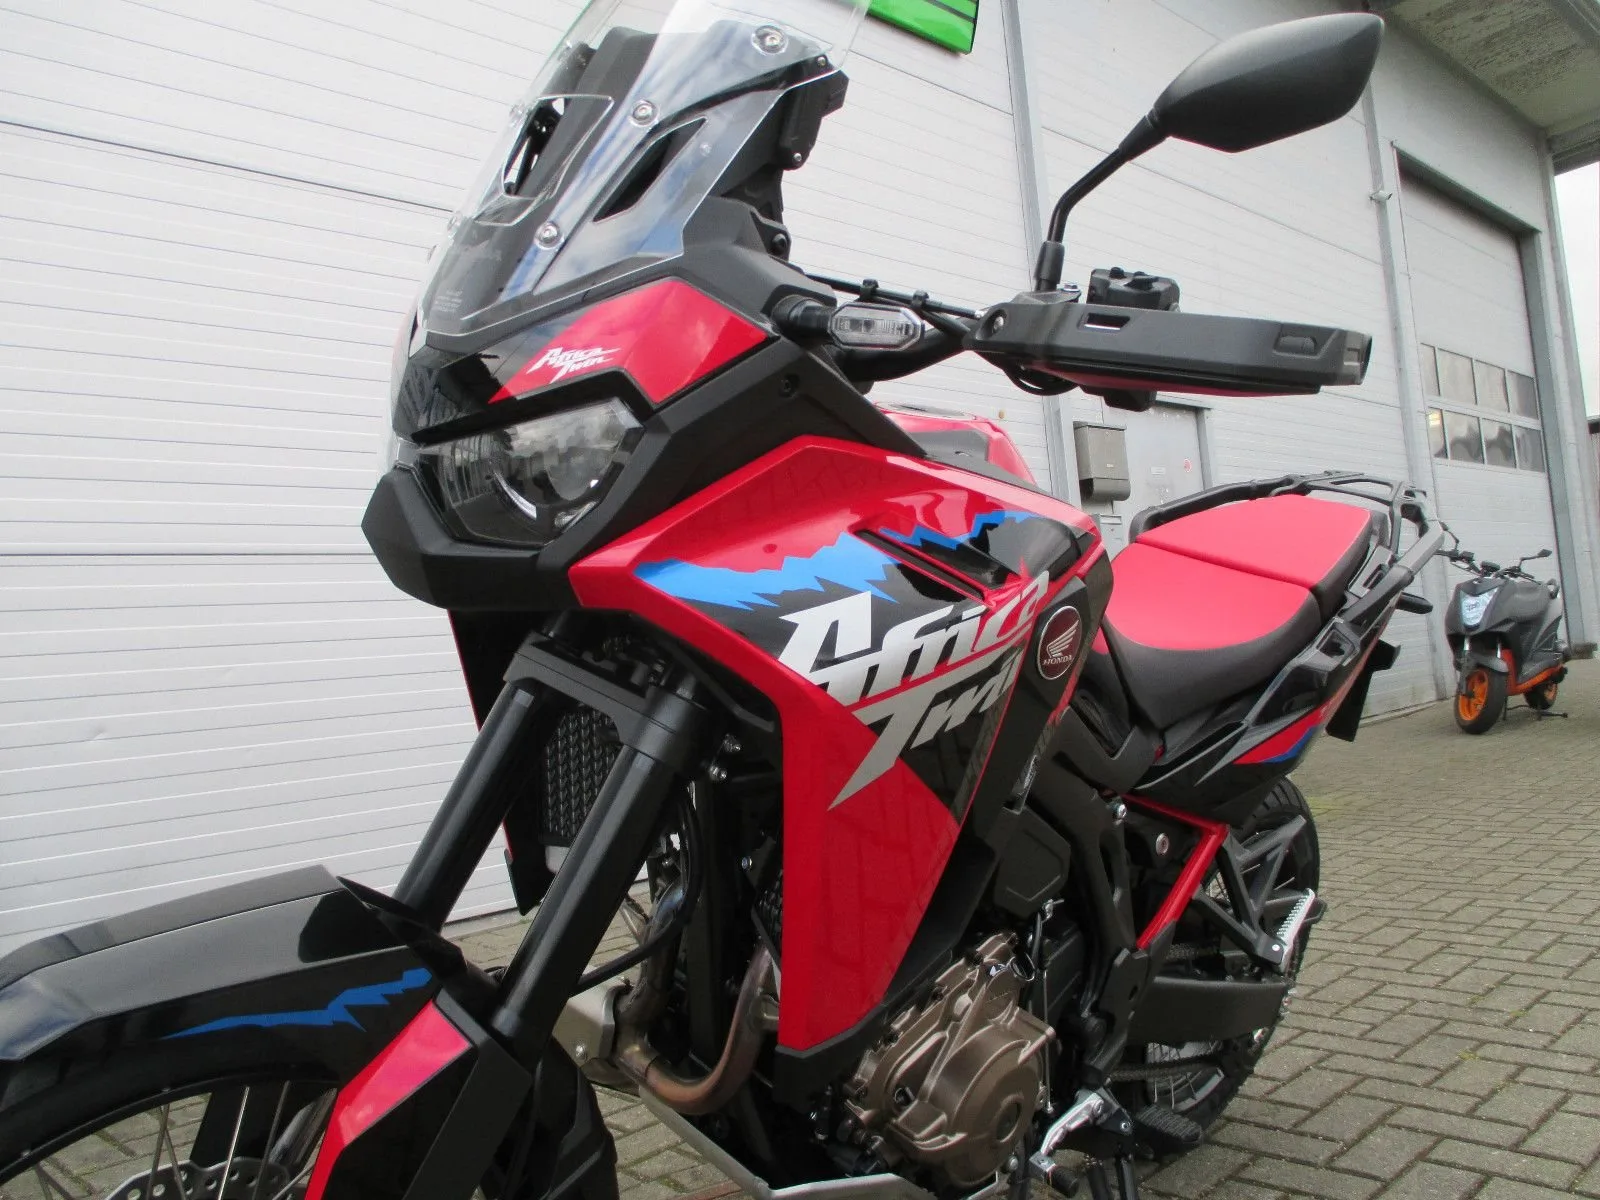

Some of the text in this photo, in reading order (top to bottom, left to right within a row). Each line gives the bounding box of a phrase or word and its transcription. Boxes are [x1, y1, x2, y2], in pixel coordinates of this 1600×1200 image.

[526, 347, 621, 374] Africa
[549, 356, 614, 385] Twin
[778, 570, 1049, 707] Africa
[1042, 654, 1073, 666] HONDA
